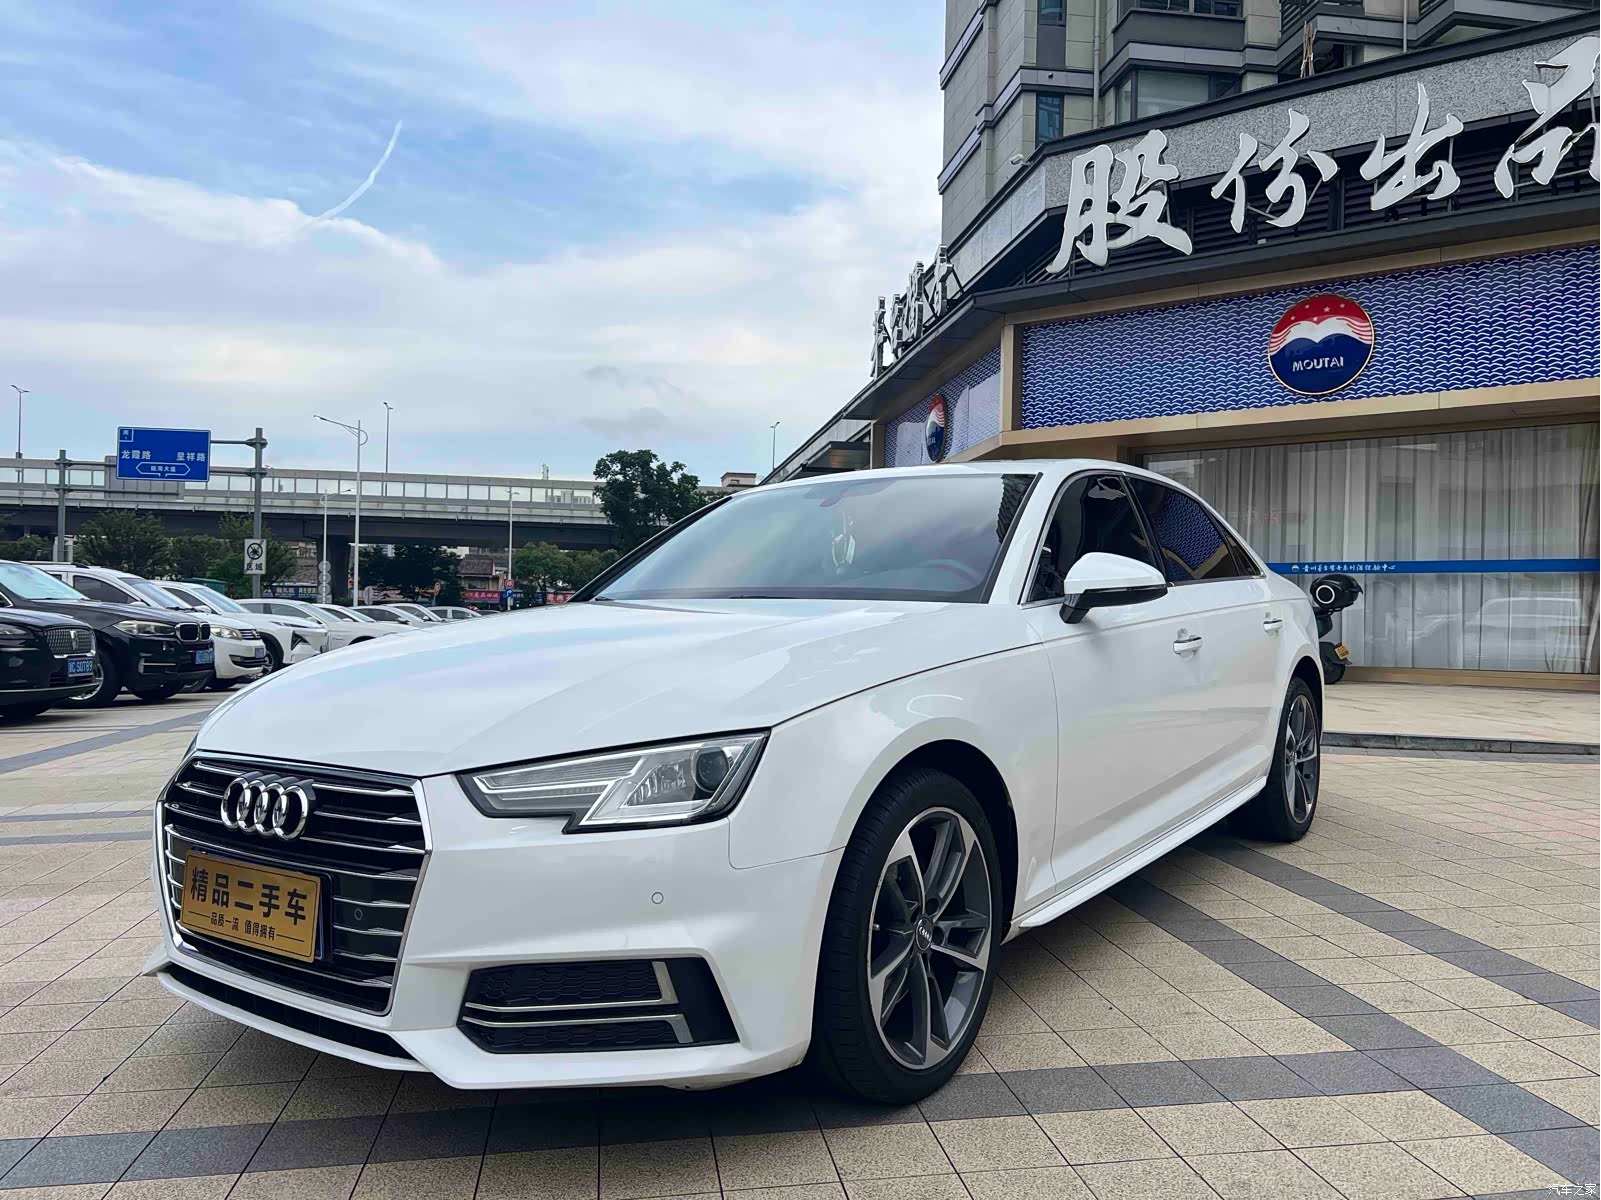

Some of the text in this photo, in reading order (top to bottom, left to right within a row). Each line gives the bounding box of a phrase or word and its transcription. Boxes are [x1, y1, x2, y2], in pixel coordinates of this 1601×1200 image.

[1293, 356, 1344, 372] MOUTAI
[121, 450, 151, 460] 龙霞路
[191, 866, 307, 926] 精品二手车
[210, 911, 276, 941] 品质一流 值得拥有
